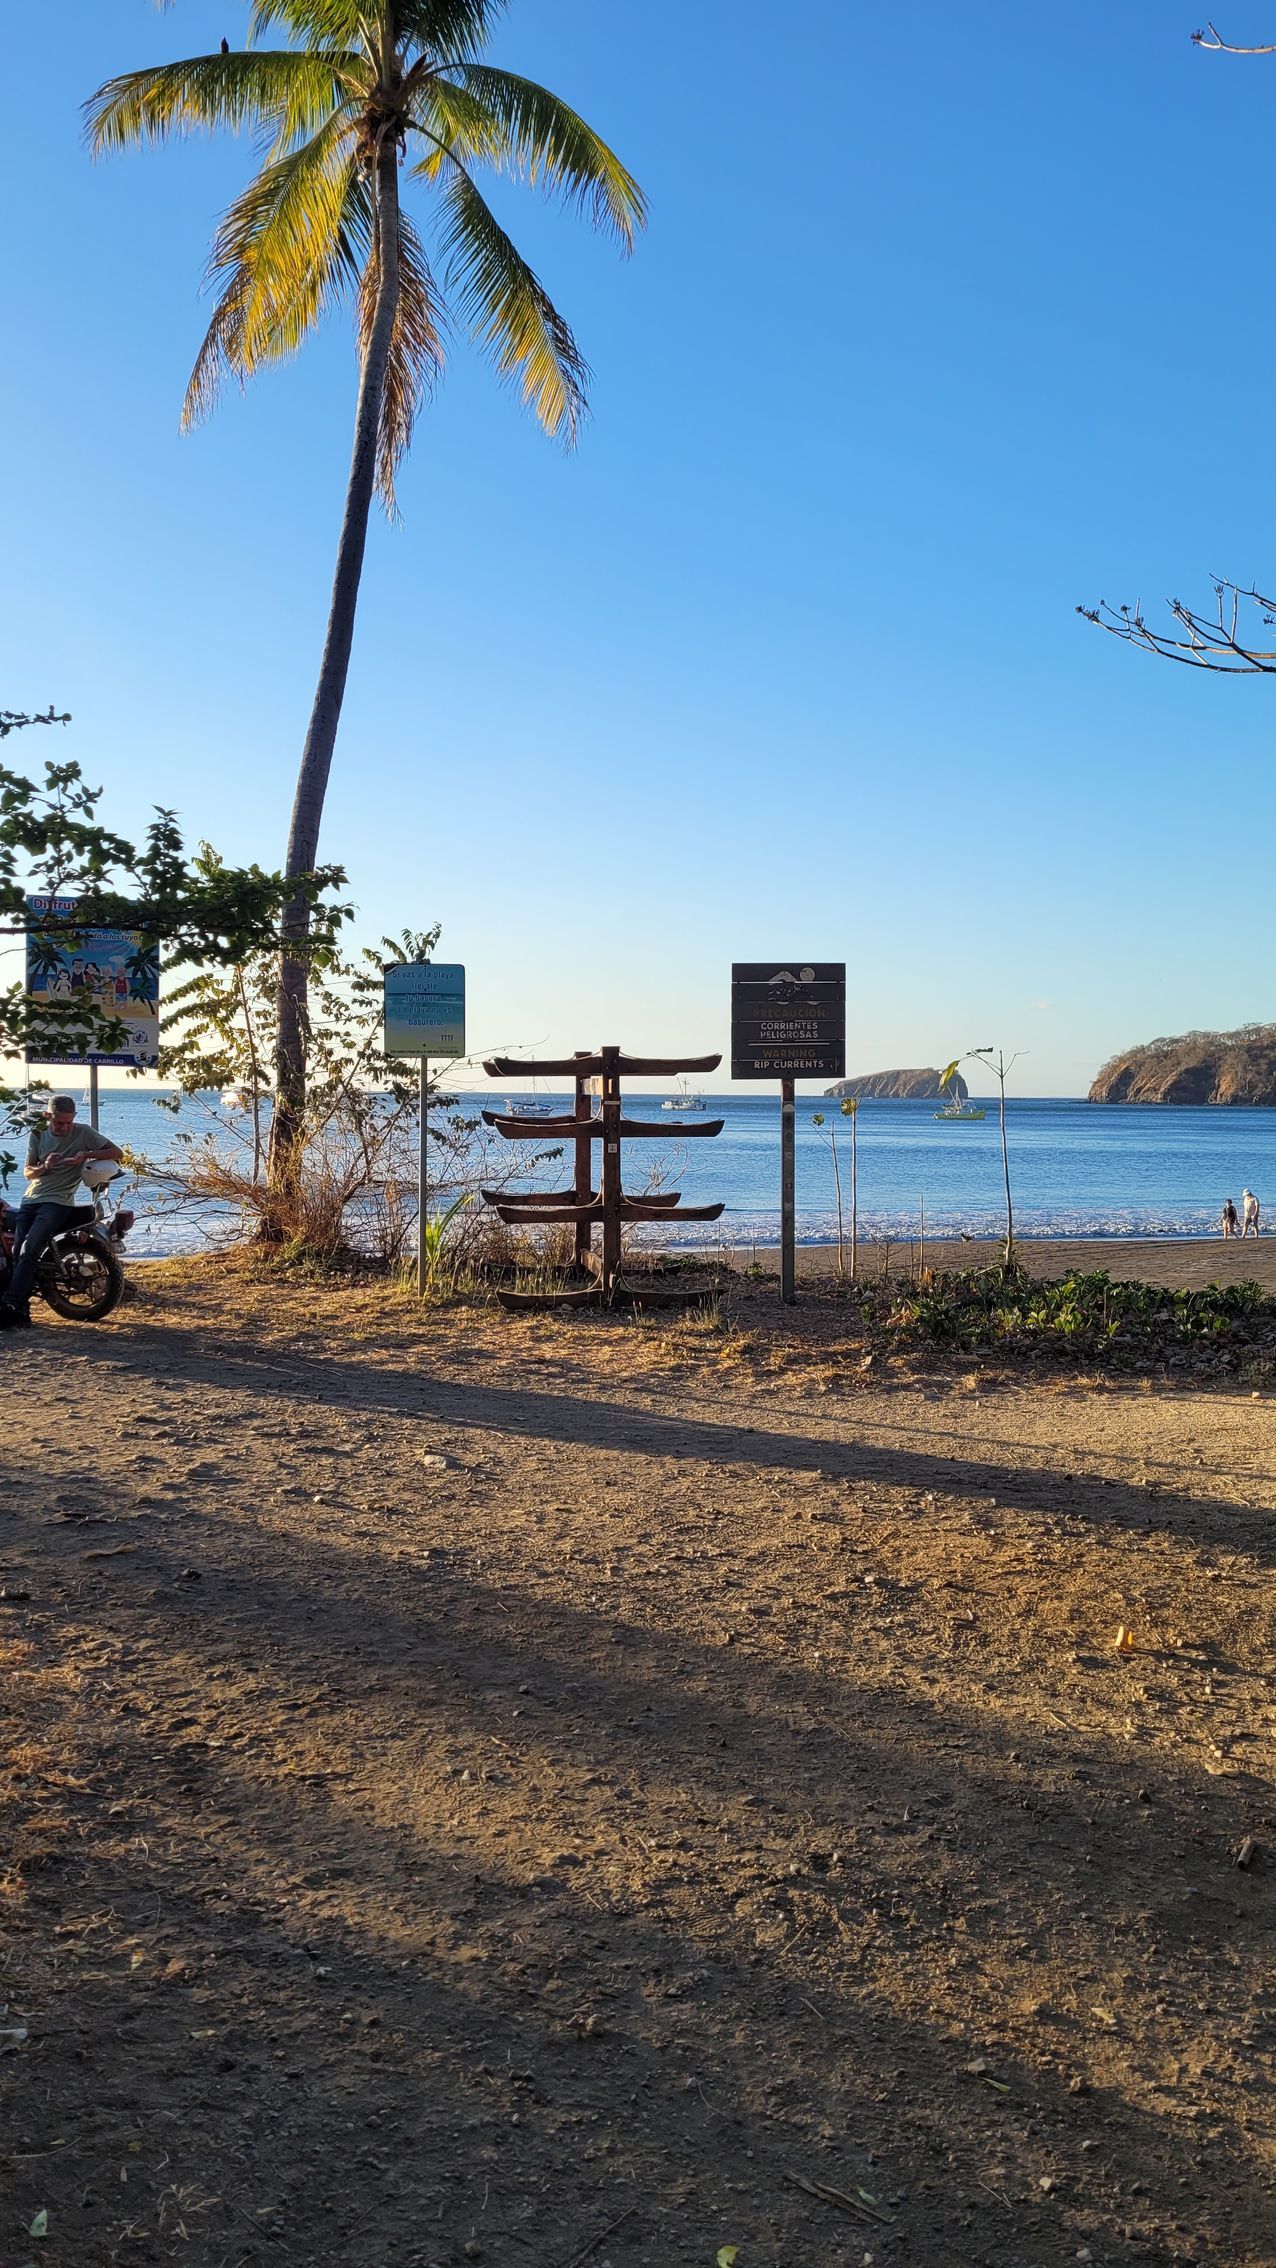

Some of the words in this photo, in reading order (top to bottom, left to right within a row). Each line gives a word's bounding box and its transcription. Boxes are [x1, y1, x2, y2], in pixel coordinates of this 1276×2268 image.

[760, 1022, 818, 1030] CORRIENTES
[760, 1030, 818, 1039] PELIGROSAS
[763, 1048, 816, 1058] WARNING
[754, 1060, 770, 1069] RIP
[773, 1060, 824, 1069] CURRENTS
